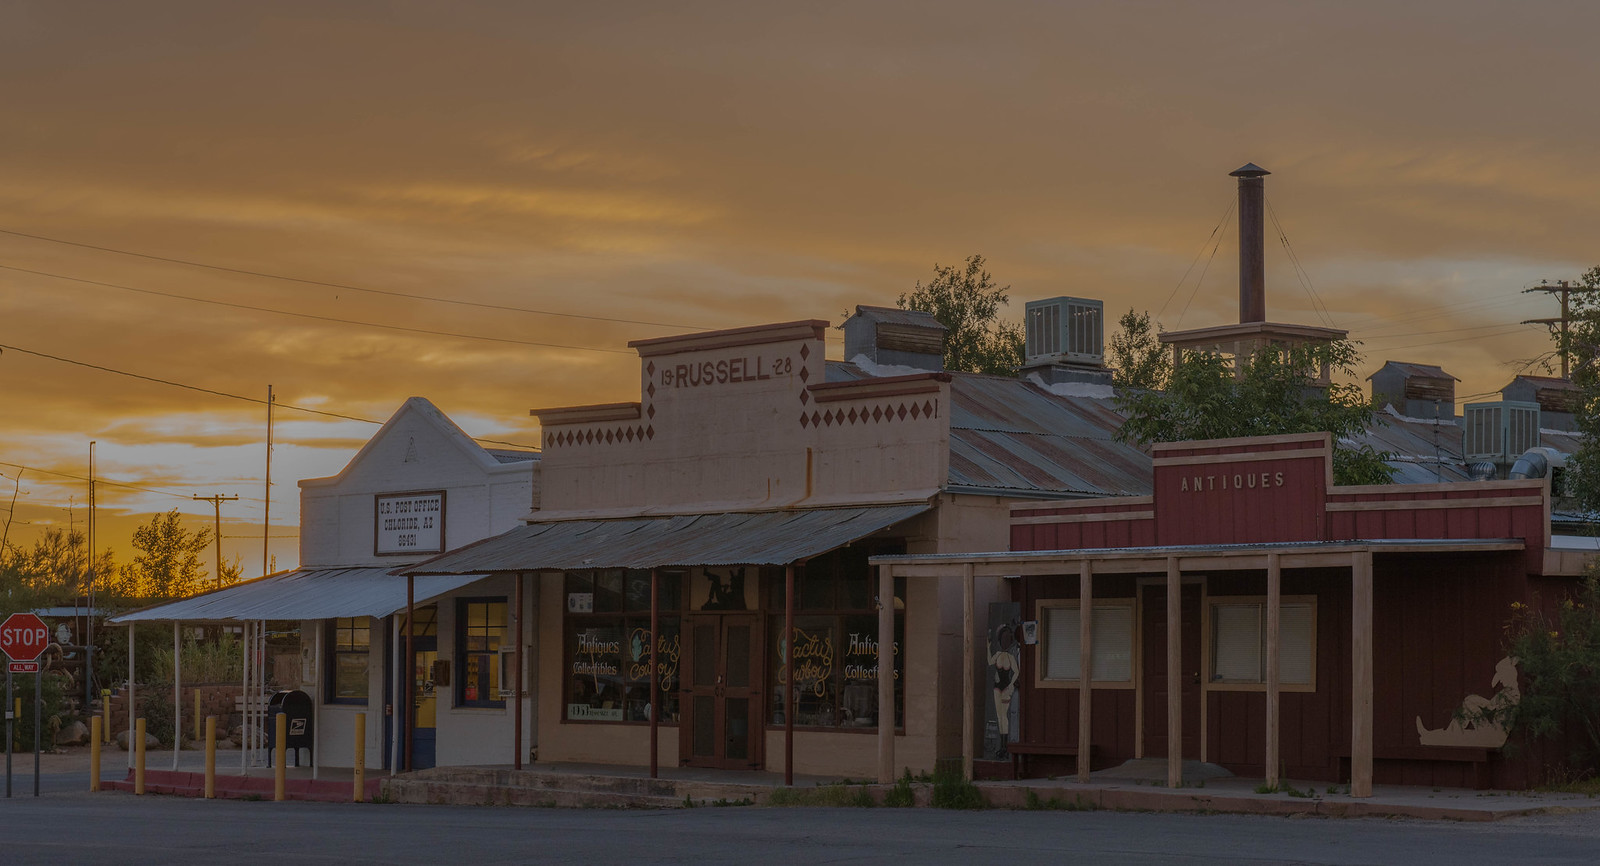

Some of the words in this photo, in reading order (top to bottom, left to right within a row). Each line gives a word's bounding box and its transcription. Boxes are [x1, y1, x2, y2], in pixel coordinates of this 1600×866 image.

[675, 356, 771, 389] RUSSELL
[1181, 471, 1284, 492] ANTIQUES
[380, 502, 392, 515] U.S.
[396, 501, 412, 513] POST
[415, 499, 439, 512] OFFICE
[385, 518, 420, 531] CHLORIDE,
[424, 517, 433, 528] AZ
[3, 628, 46, 646] STOP
[575, 632, 620, 658] Antiques
[629, 627, 680, 662] Catus
[845, 632, 899, 660] Antiqs
[572, 660, 617, 677] Collectibles
